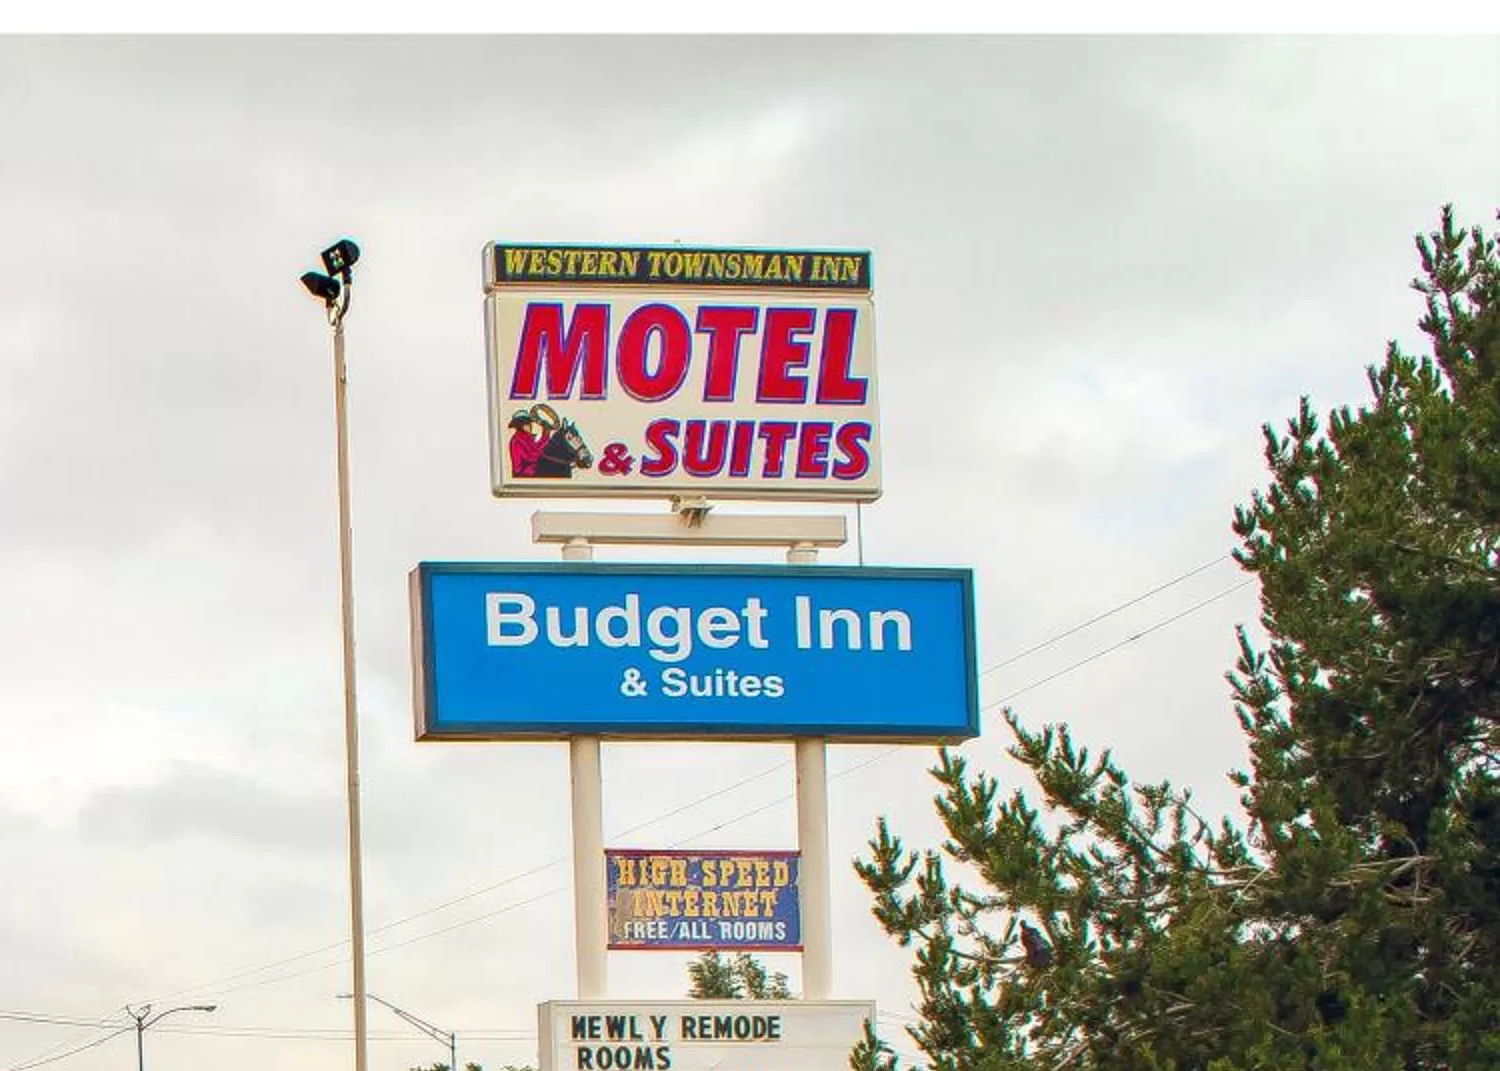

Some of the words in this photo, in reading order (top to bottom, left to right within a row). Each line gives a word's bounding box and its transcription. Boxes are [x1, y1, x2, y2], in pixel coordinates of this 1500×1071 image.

[503, 248, 641, 277] WESTERN
[647, 250, 804, 281] TOWNSMAN
[809, 255, 862, 283] INN
[508, 302, 869, 405] MOTEL
[597, 443, 636, 477] &
[639, 418, 872, 480] SUITES
[485, 591, 770, 663] Budget
[795, 595, 914, 652] Inn
[620, 668, 648, 698] &
[661, 667, 786, 699] Suites
[616, 858, 688, 887] HIGH
[702, 859, 790, 888] SPEED
[632, 890, 778, 918] INTERNET
[623, 921, 712, 940] FREE/ALL
[717, 921, 787, 941] ROOMS
[680, 1015, 781, 1039] REMODE
[577, 1045, 671, 1071] ROOMS
